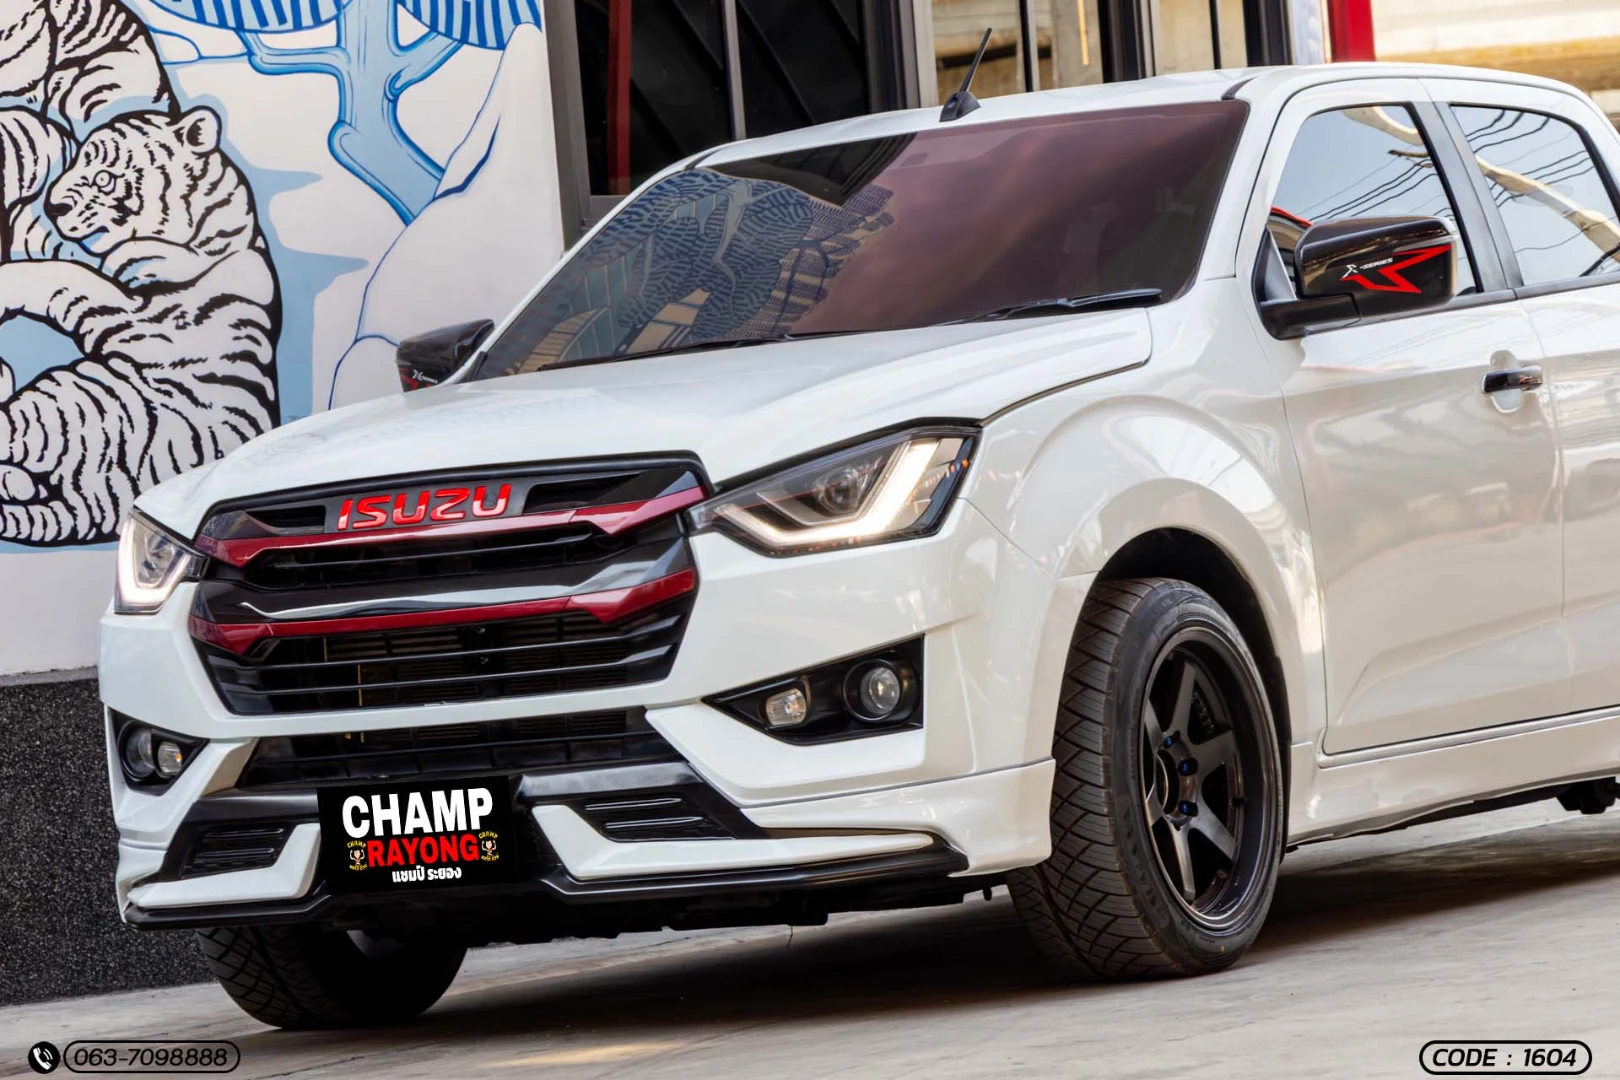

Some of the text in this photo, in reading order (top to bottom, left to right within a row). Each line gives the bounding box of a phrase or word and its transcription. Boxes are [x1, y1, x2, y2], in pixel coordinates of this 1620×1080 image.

[337, 483, 513, 531] ISUZU
[342, 787, 493, 838] CHAMP
[366, 833, 479, 868] RAYONG
[427, 866, 462, 881] ระยอง
